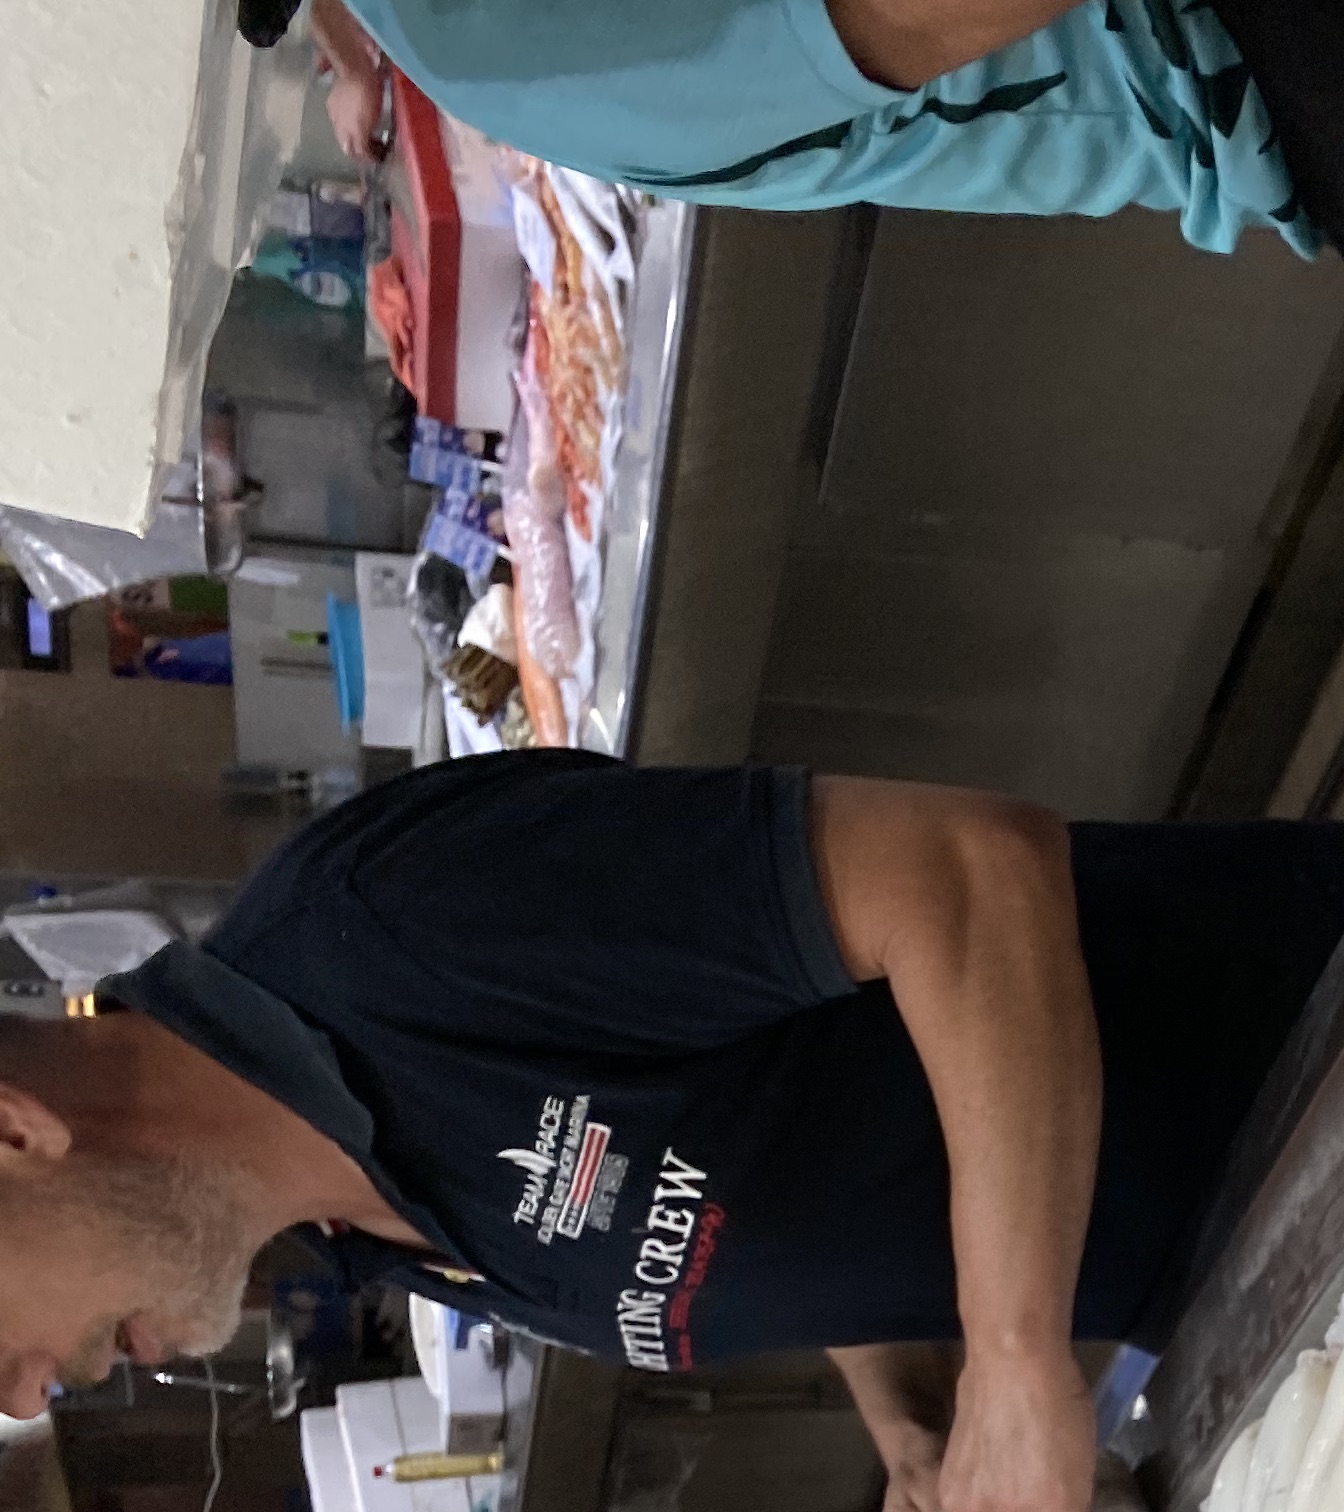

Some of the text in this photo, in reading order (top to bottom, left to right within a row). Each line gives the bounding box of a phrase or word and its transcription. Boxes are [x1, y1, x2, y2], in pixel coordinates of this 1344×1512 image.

[511, 1173, 548, 1225] TEAM
[534, 1095, 565, 1158] RACE
[634, 1146, 708, 1285] CREW
[616, 1288, 669, 1372] HTING
